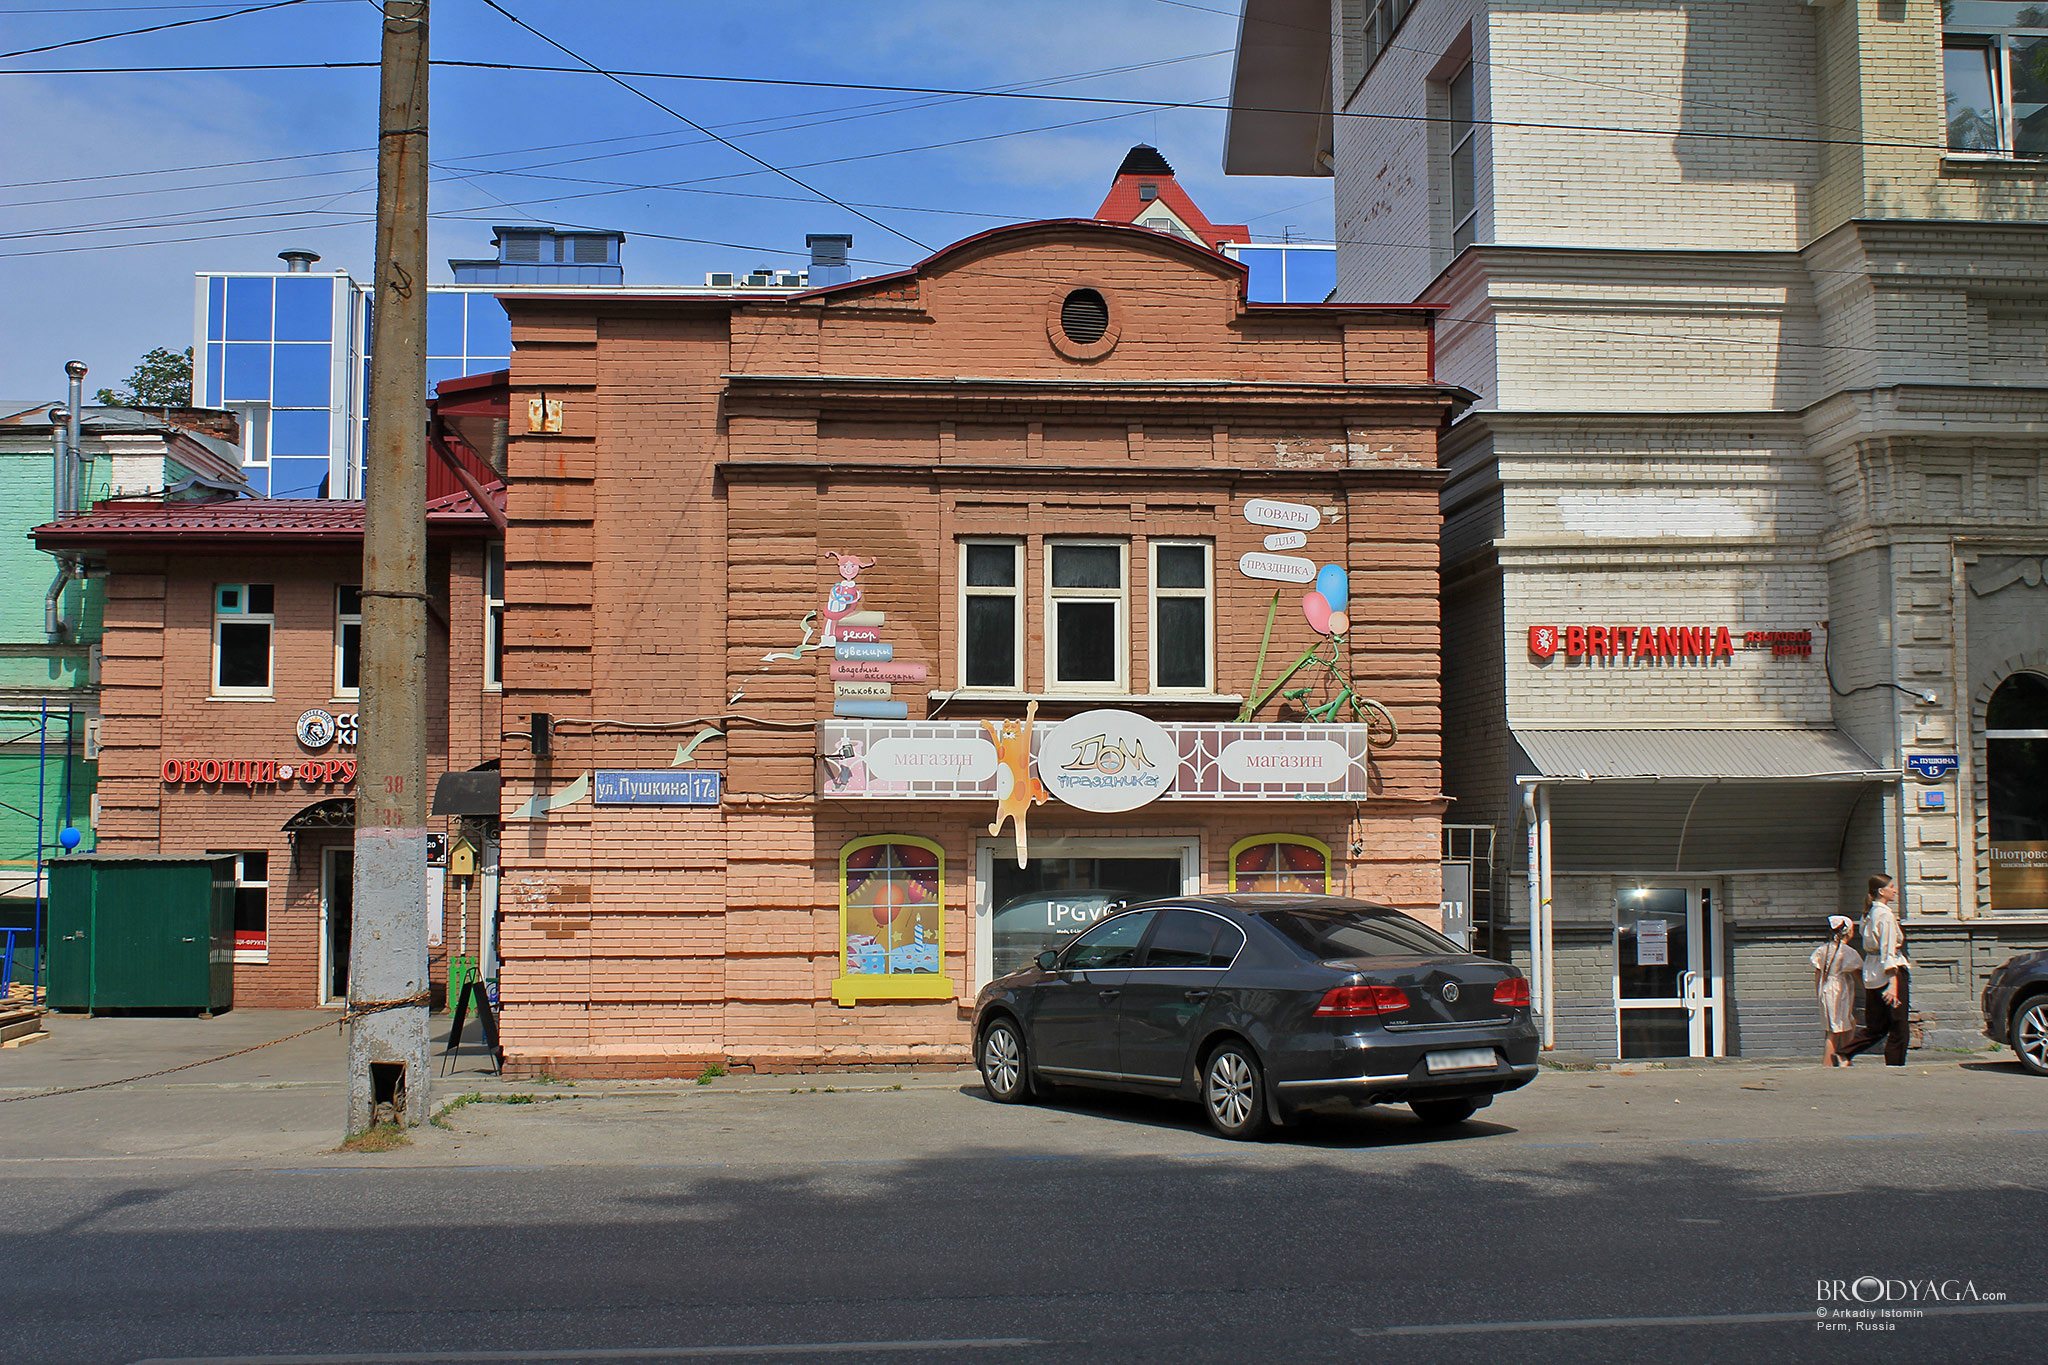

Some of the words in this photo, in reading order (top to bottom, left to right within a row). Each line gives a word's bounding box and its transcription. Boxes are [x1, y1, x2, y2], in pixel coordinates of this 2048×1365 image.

[1256, 506, 1309, 523] ТОВАРЫ
[1274, 536, 1297, 548] ДЛЯ
[1246, 560, 1309, 576] ПРАЗДНИКА
[842, 630, 877, 642] декор
[1566, 625, 1735, 657] BRITANNIA
[894, 752, 973, 766] магазин
[1246, 755, 1323, 768] магазин
[163, 759, 276, 788] ОВОЩИ
[1928, 766, 1940, 775] 15
[384, 775, 404, 793] 38
